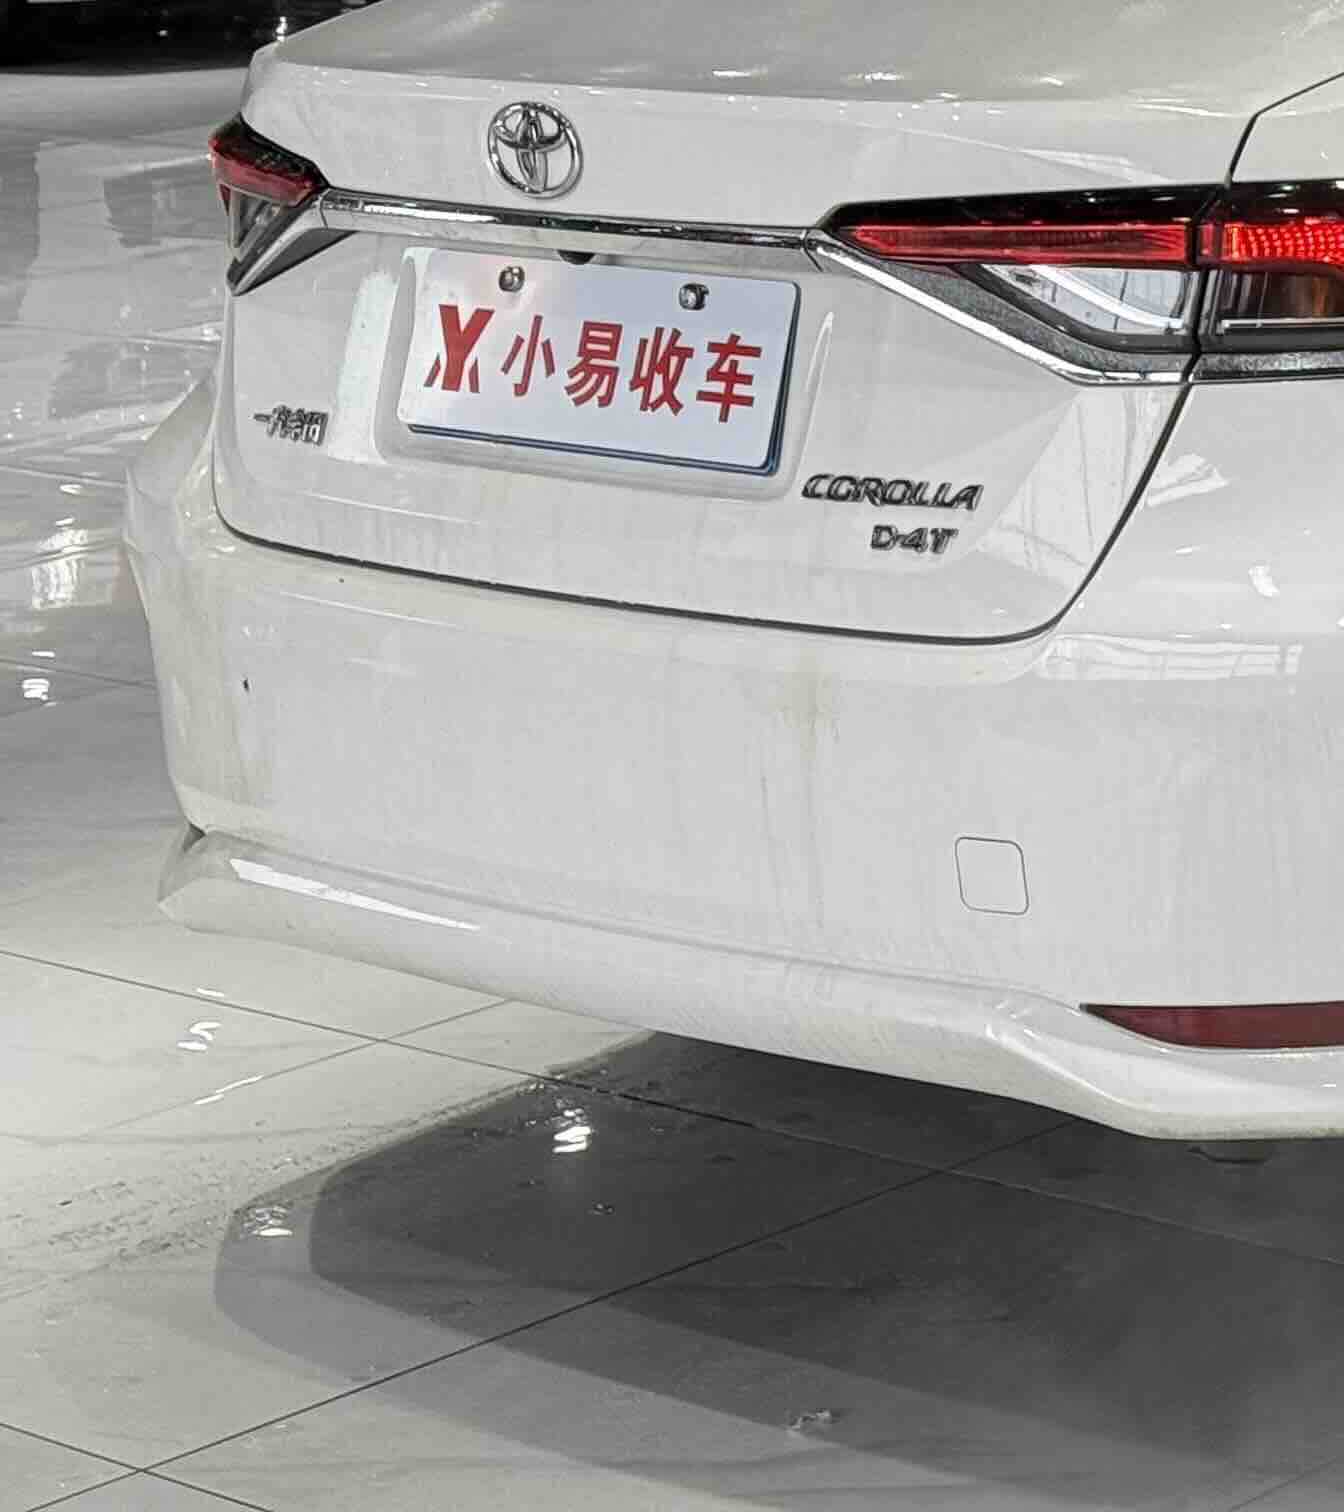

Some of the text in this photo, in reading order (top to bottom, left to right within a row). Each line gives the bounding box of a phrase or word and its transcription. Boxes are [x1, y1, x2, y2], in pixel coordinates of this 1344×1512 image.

[500, 314, 763, 424] 小易收车
[802, 474, 984, 510] COROLLA
[871, 524, 959, 554] D-4T
